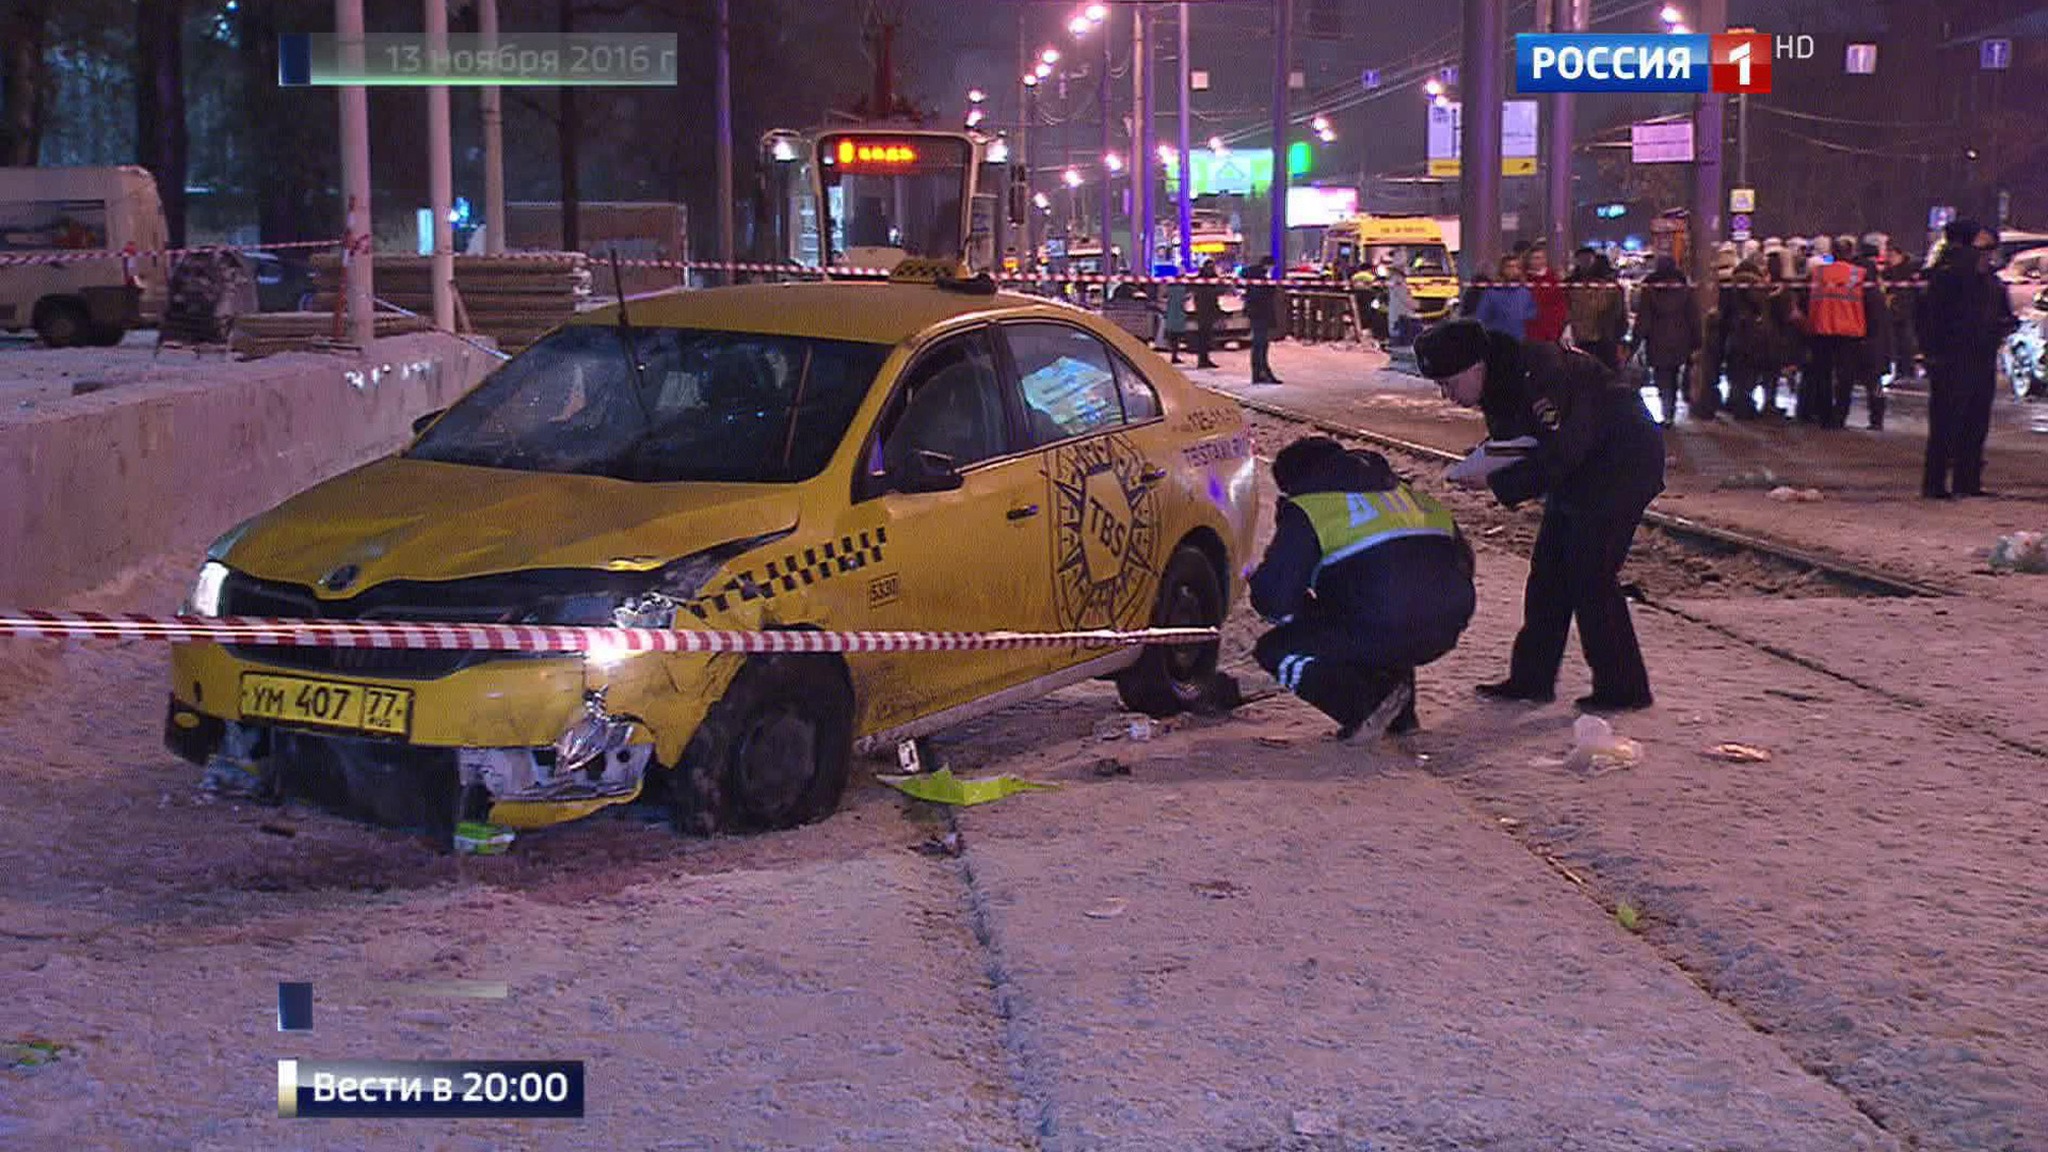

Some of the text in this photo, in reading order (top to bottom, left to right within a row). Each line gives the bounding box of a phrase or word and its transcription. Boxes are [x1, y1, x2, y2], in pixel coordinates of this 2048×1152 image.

[1090, 496, 1126, 557] TBS
[295, 684, 351, 720] 407
[369, 691, 396, 717] 77
